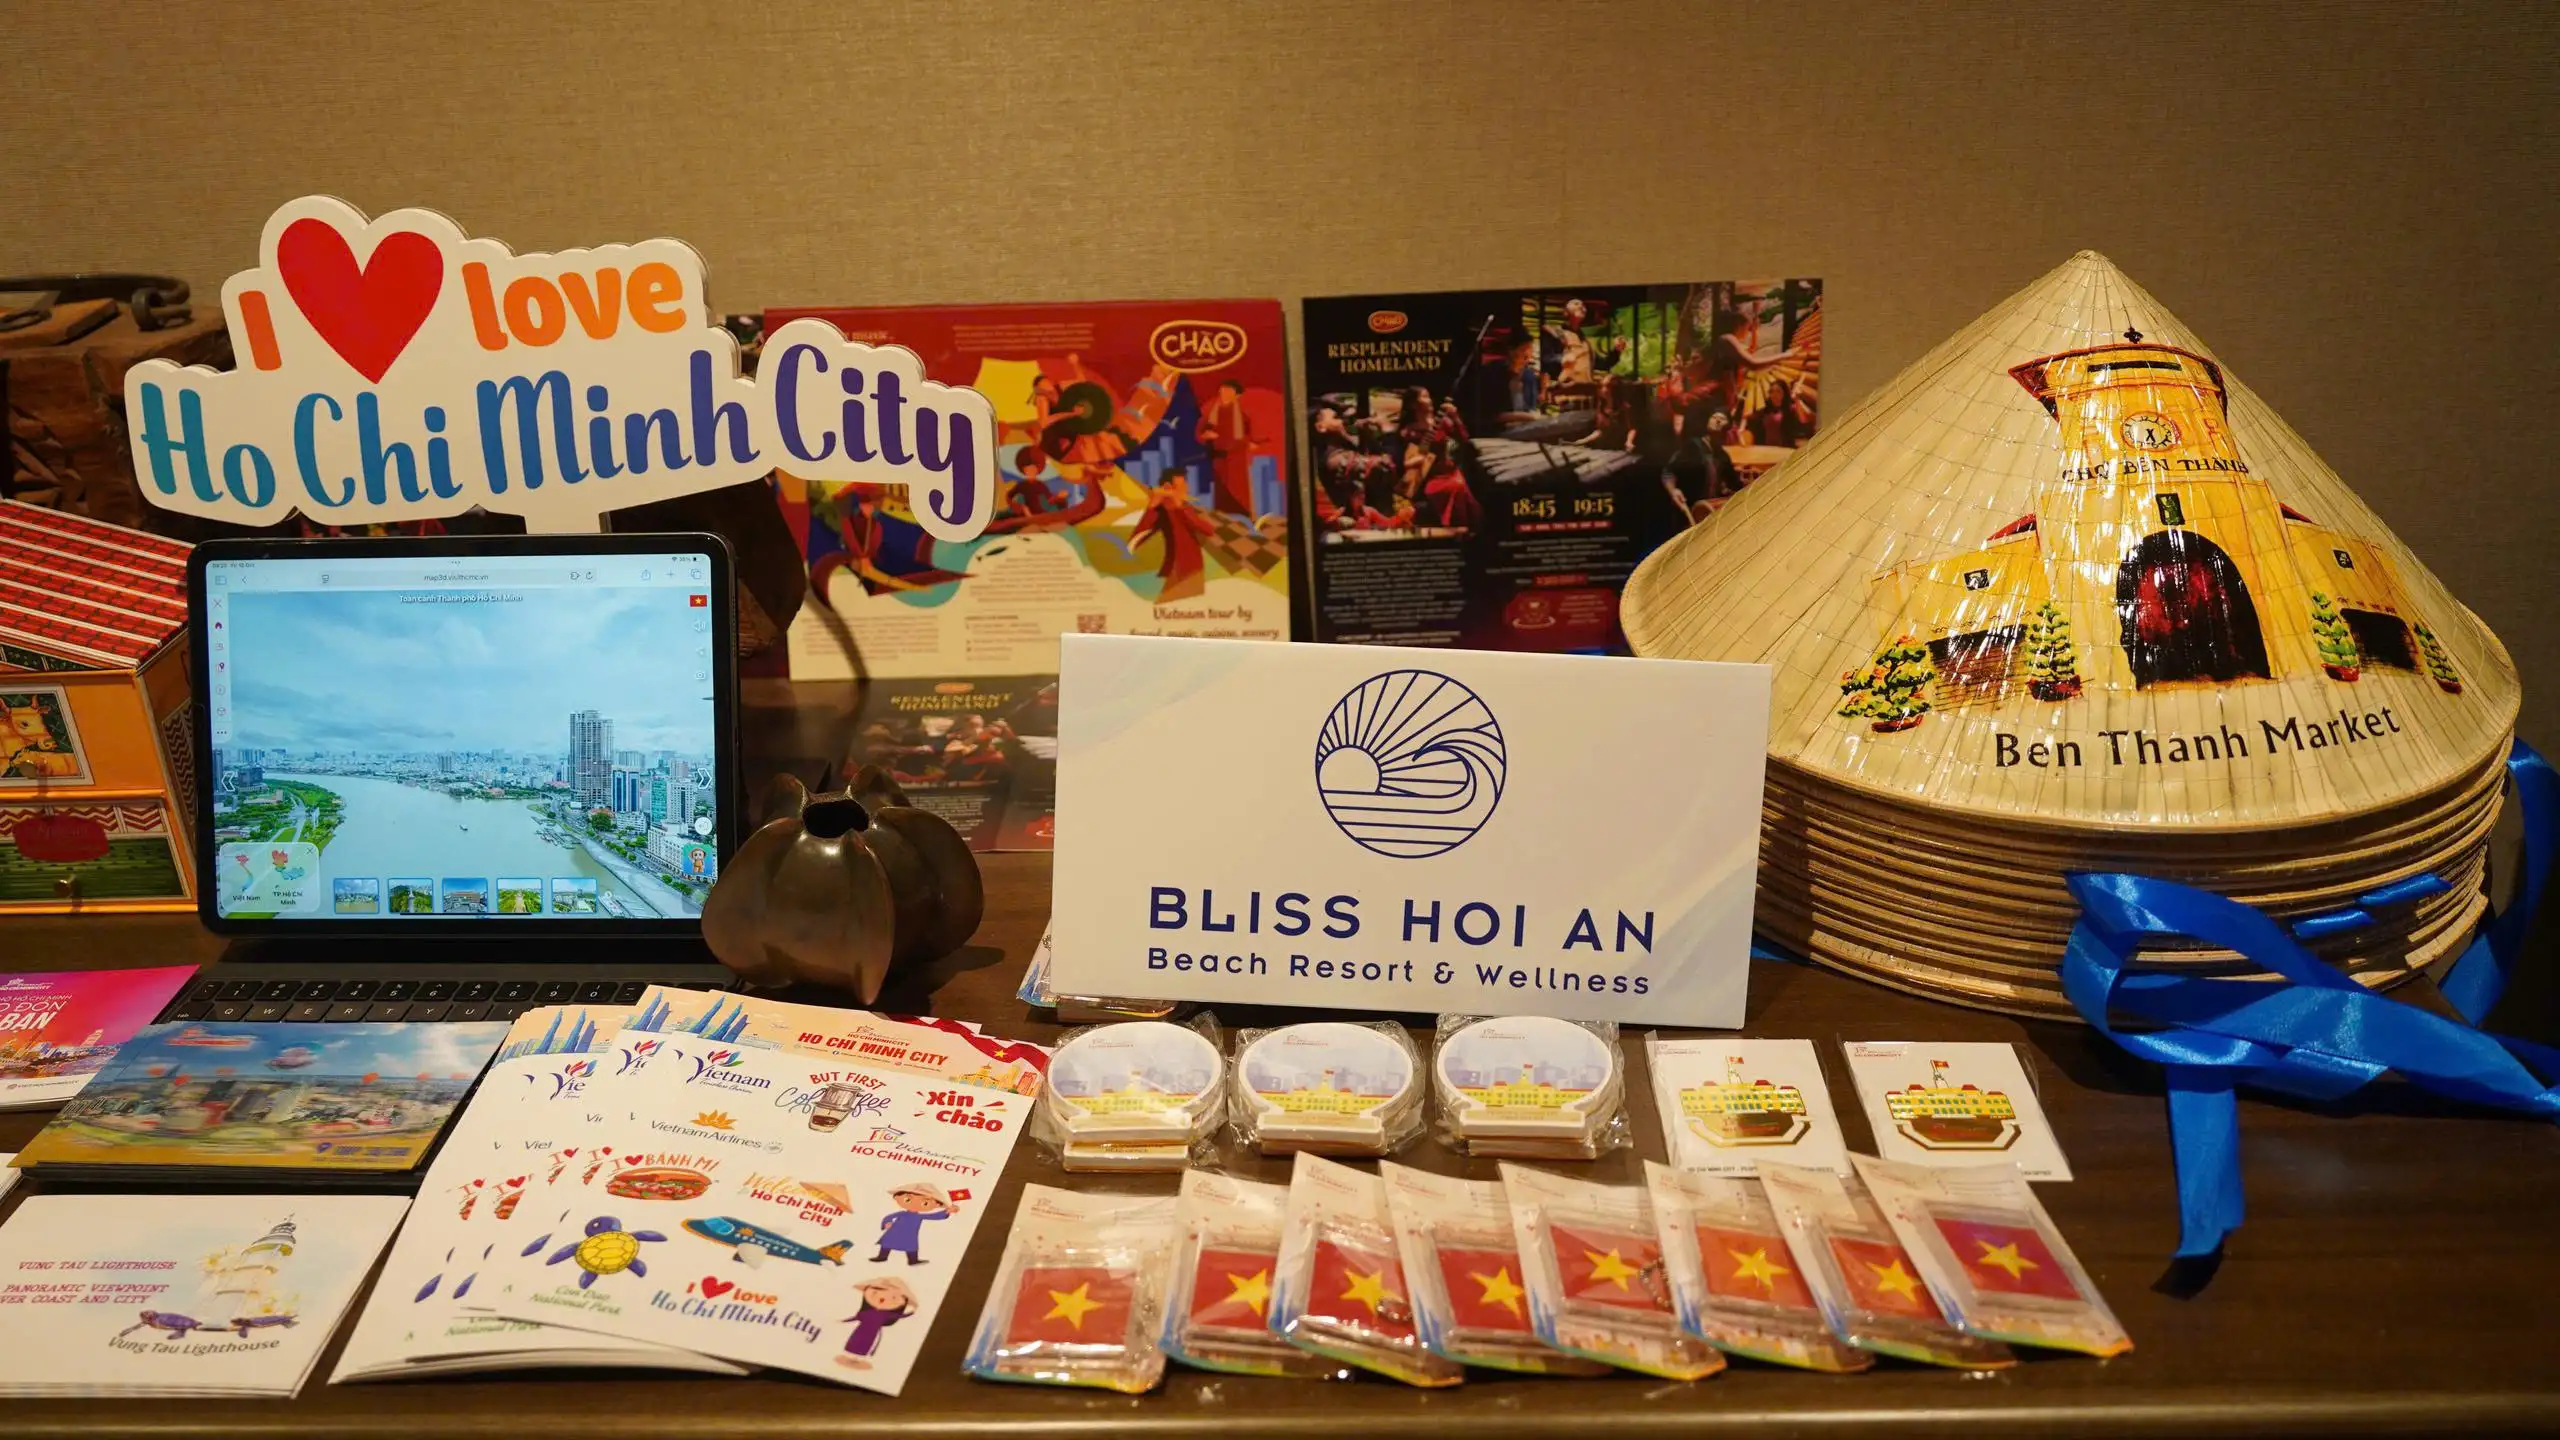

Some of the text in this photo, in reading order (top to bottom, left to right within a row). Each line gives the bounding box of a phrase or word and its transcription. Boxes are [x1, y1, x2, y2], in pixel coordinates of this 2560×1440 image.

[238, 260, 688, 371] I love
[1328, 340, 1452, 358] RESPLENDENT
[1340, 356, 1441, 373] HOMELAND
[139, 343, 977, 525] Ho Chi Minh City
[1512, 497, 1614, 518] 18:45 19:15
[1153, 604, 1253, 622] Vietnam tour by
[1995, 702, 2401, 768] Ben Thanh Market
[1149, 886, 1655, 954] BLISS HOI AN
[1148, 947, 1650, 995] Beach Resort & Wellness
[798, 1032, 823, 1045] HO
[826, 1037, 857, 1051] CHI
[859, 1042, 907, 1059] MINH
[909, 1051, 949, 1066] CITY
[686, 1056, 771, 1089] Vietnam
[810, 1071, 887, 1090] BUT FIRST
[850, 1145, 982, 1177] HO CHI MINH CITY
[750, 1188, 844, 1217] Ho Chi Minh
[799, 1210, 832, 1227] City
[19, 1261, 177, 1270] VUNG TAU LIGHTHOUSE
[0, 1295, 151, 1304] VER COAST AND CITY
[4, 1284, 170, 1293] PANORAMIC VIEWPOINT
[686, 1281, 778, 1305] I love
[650, 1290, 822, 1343] Ho Chi Minh City
[108, 1336, 281, 1357] Vung Tau Lighthouse
